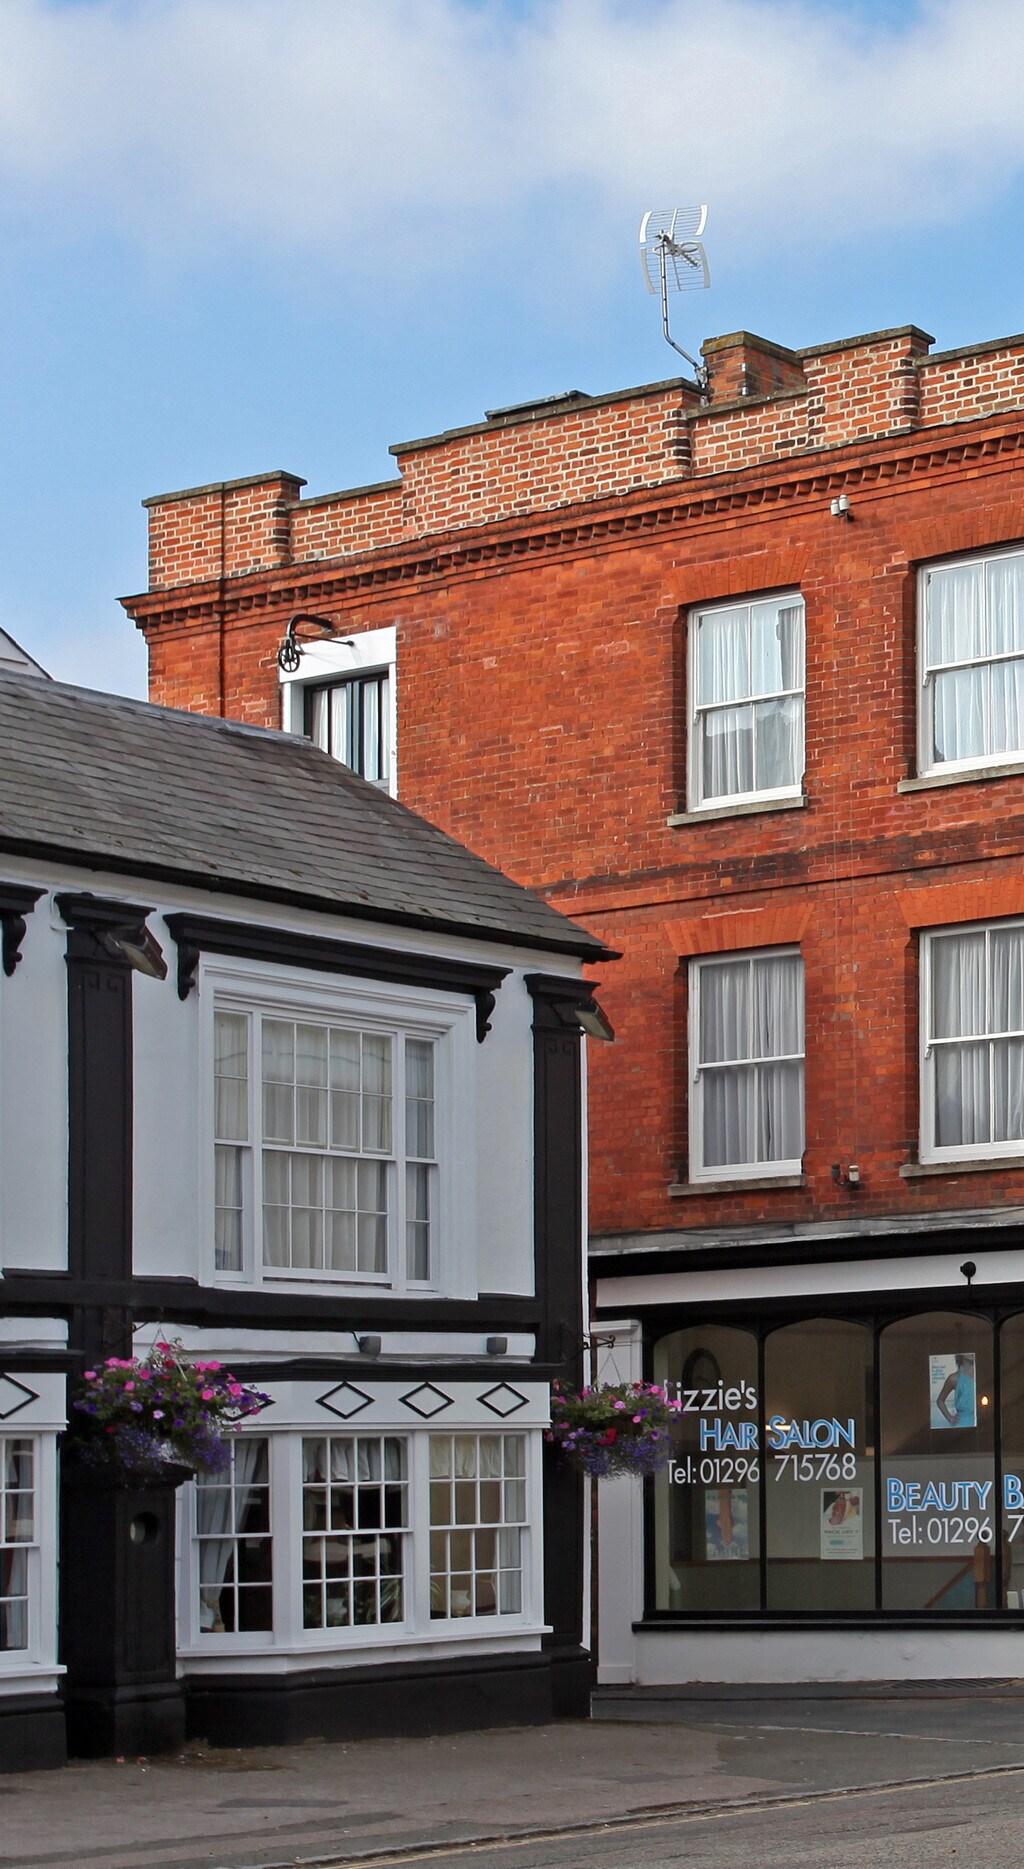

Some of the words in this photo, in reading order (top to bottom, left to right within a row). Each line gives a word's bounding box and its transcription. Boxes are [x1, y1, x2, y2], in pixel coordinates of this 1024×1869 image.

[700, 1417, 760, 1451] HAIR
[768, 1415, 856, 1449] SALON
[774, 1453, 857, 1482] 715768
[887, 1478, 993, 1511] BEAUTY
